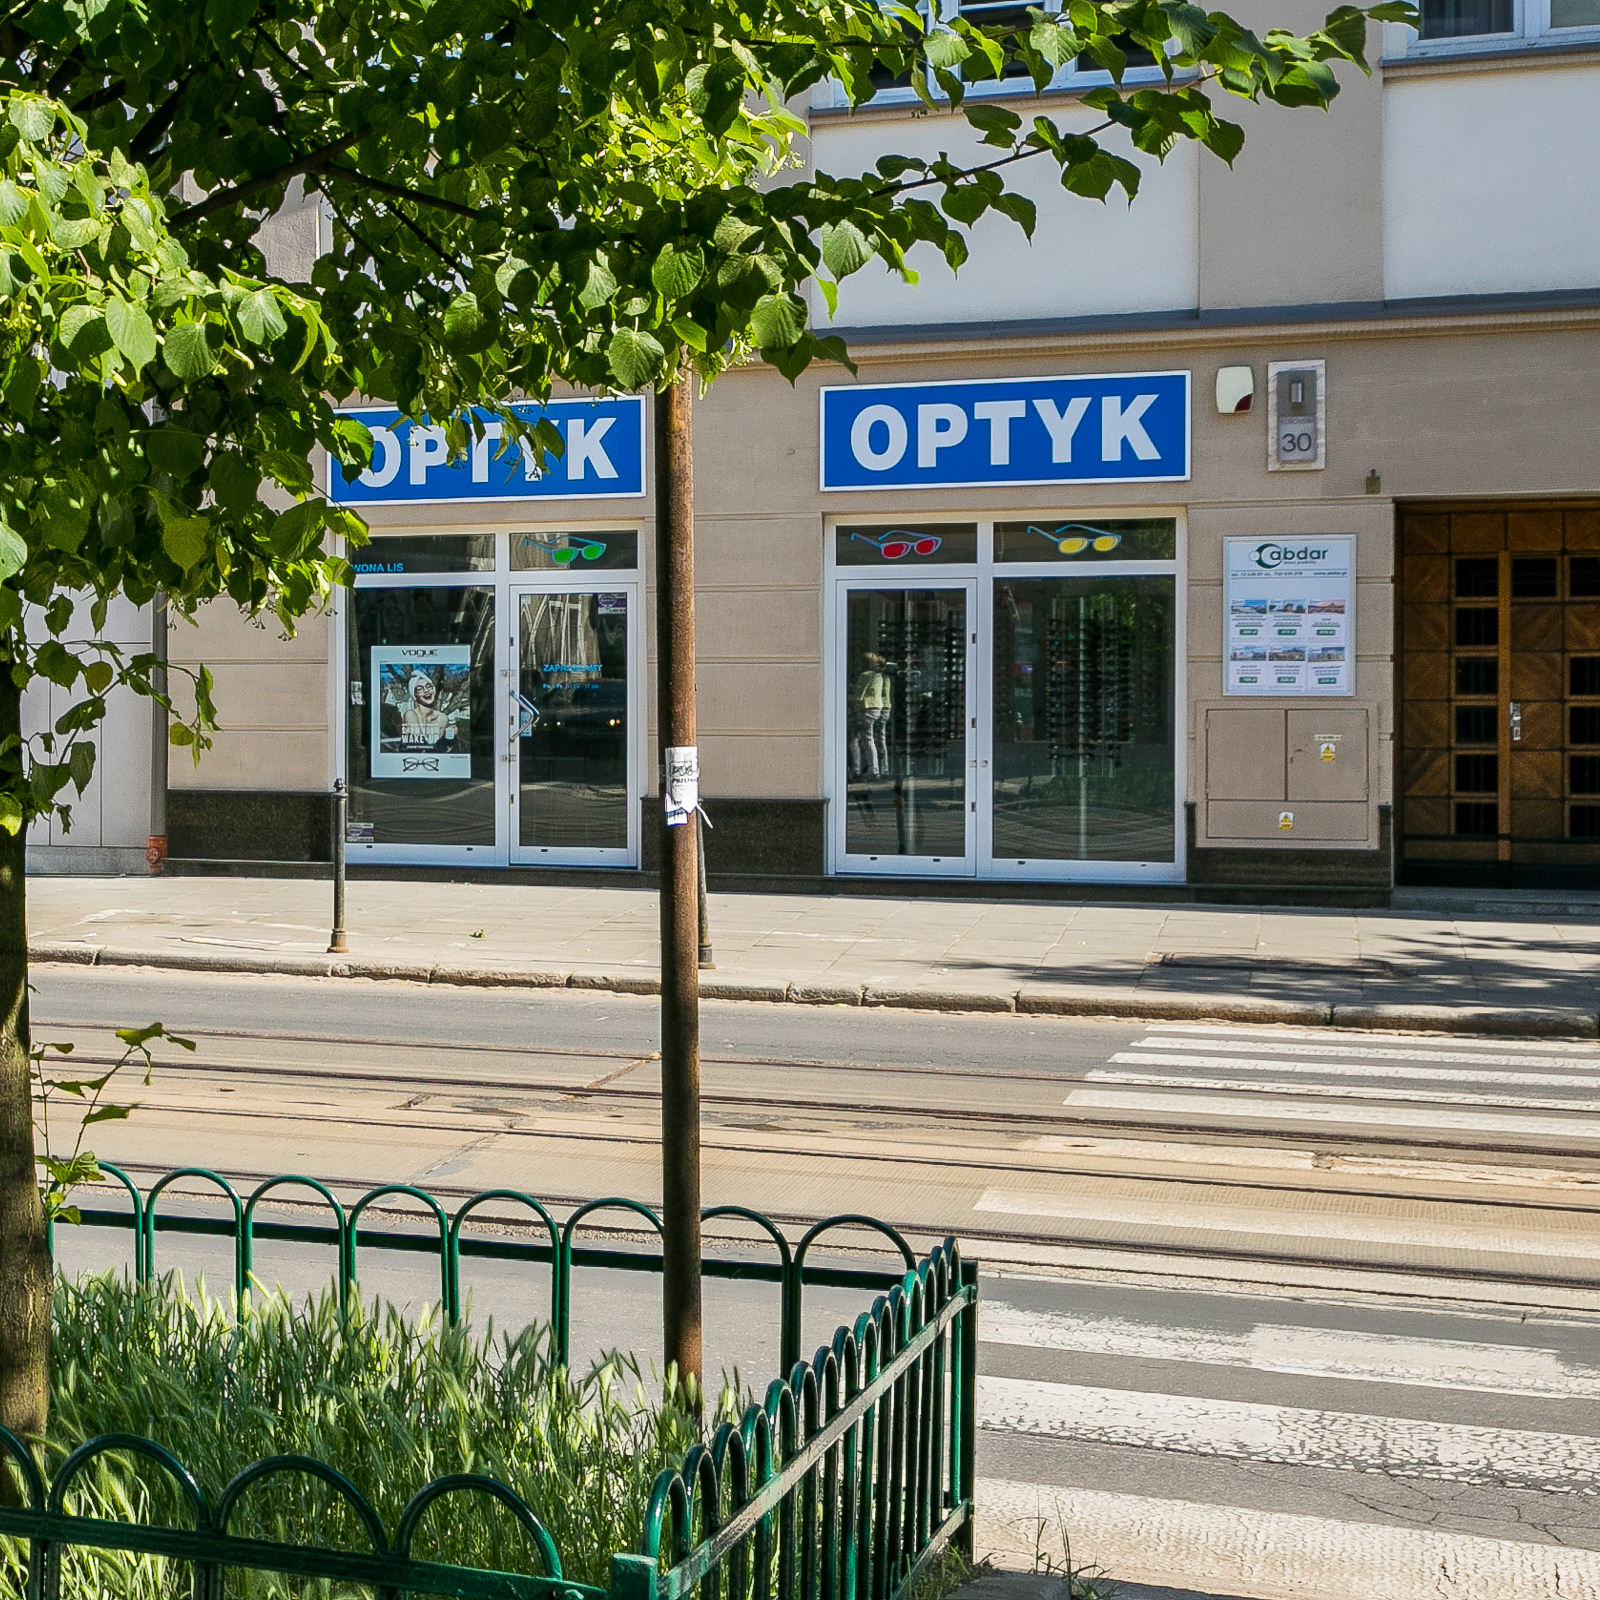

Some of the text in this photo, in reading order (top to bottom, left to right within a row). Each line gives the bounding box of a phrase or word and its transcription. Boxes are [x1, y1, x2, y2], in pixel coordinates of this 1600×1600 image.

[850, 394, 1162, 472] OPTYK
[1282, 432, 1312, 453] 30
[1270, 546, 1329, 560] abdar
[351, 562, 404, 572] WONA LIS
[402, 649, 438, 658] VOGUE
[402, 734, 424, 743] WAKE
